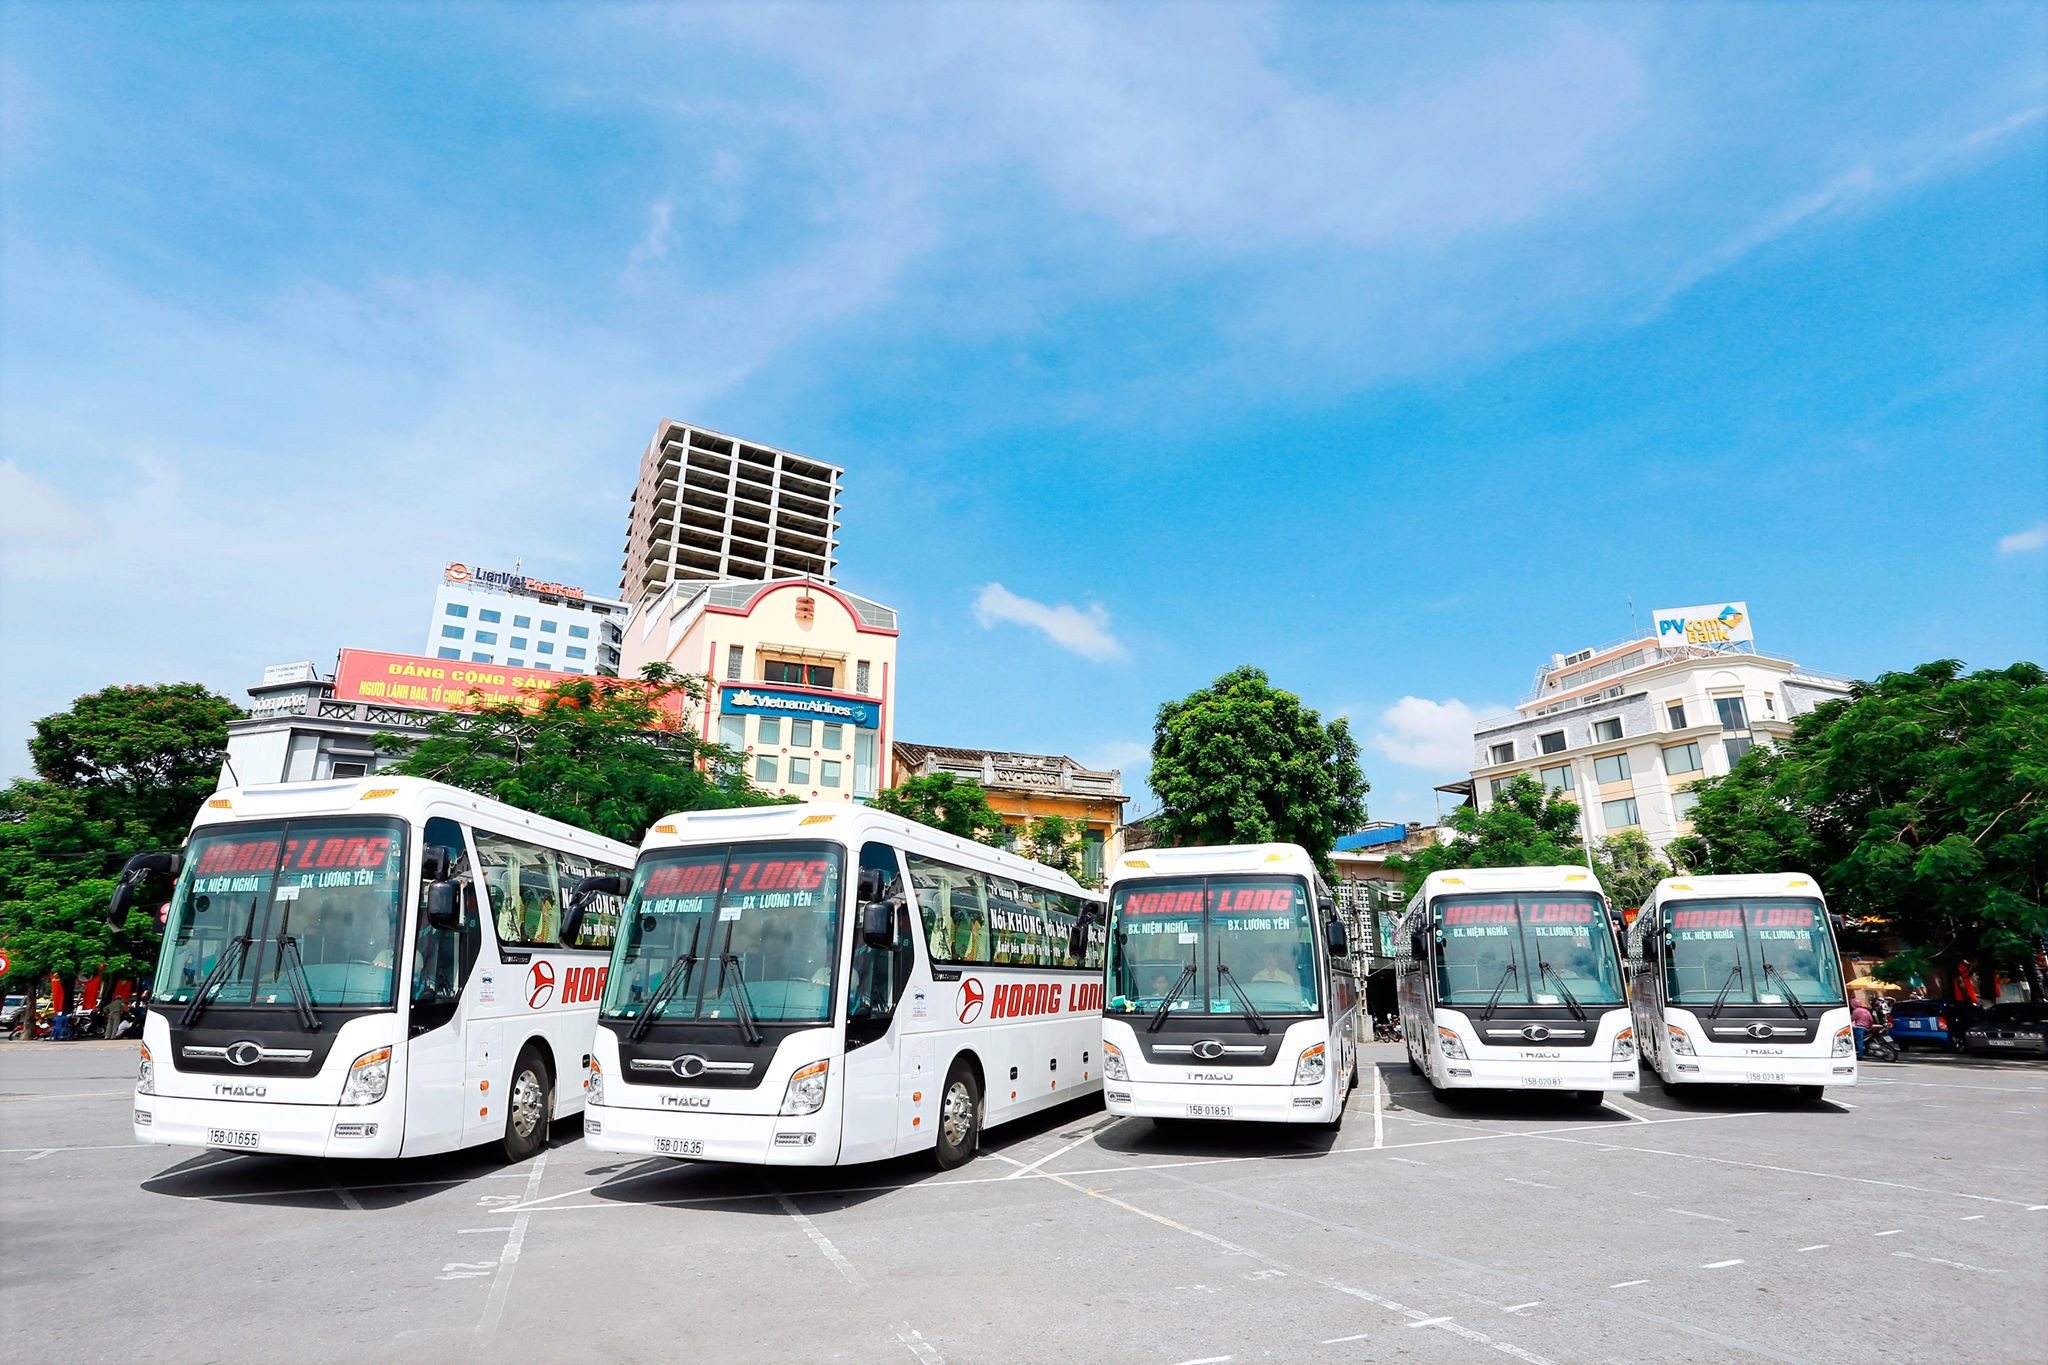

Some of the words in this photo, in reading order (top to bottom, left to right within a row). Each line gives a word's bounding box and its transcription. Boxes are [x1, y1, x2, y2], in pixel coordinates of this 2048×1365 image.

[1687, 630, 1731, 644] Bank
[388, 662, 445, 680] ĐẢNG
[452, 670, 506, 686] CỘNG
[511, 674, 552, 689] SẢN
[298, 837, 391, 868] LONG
[300, 874, 314, 889] BX
[319, 871, 351, 888] LƯƠNG
[354, 868, 374, 886] YÊN
[739, 861, 828, 890] LONG
[207, 876, 230, 894] NIỆM
[654, 898, 676, 915] NIỆM
[743, 896, 755, 911] BX
[759, 893, 790, 909] LƯƠNG
[793, 890, 812, 907] YÊN
[1217, 889, 1293, 911] LONG
[990, 907, 1006, 930] Nói
[1007, 909, 1042, 935] KHÔNG
[1530, 903, 1592, 923] LONG
[1141, 921, 1162, 936] NIỆM
[1272, 916, 1290, 930] YÊN
[1574, 925, 1590, 937] YÊN
[1466, 926, 1485, 938] NIỆM
[1695, 930, 1713, 941] NIỆM
[990, 984, 1062, 1019] HOANG
[1185, 1071, 1234, 1081] THACO
[212, 1082, 267, 1097] THACO
[659, 1093, 711, 1108] THACO
